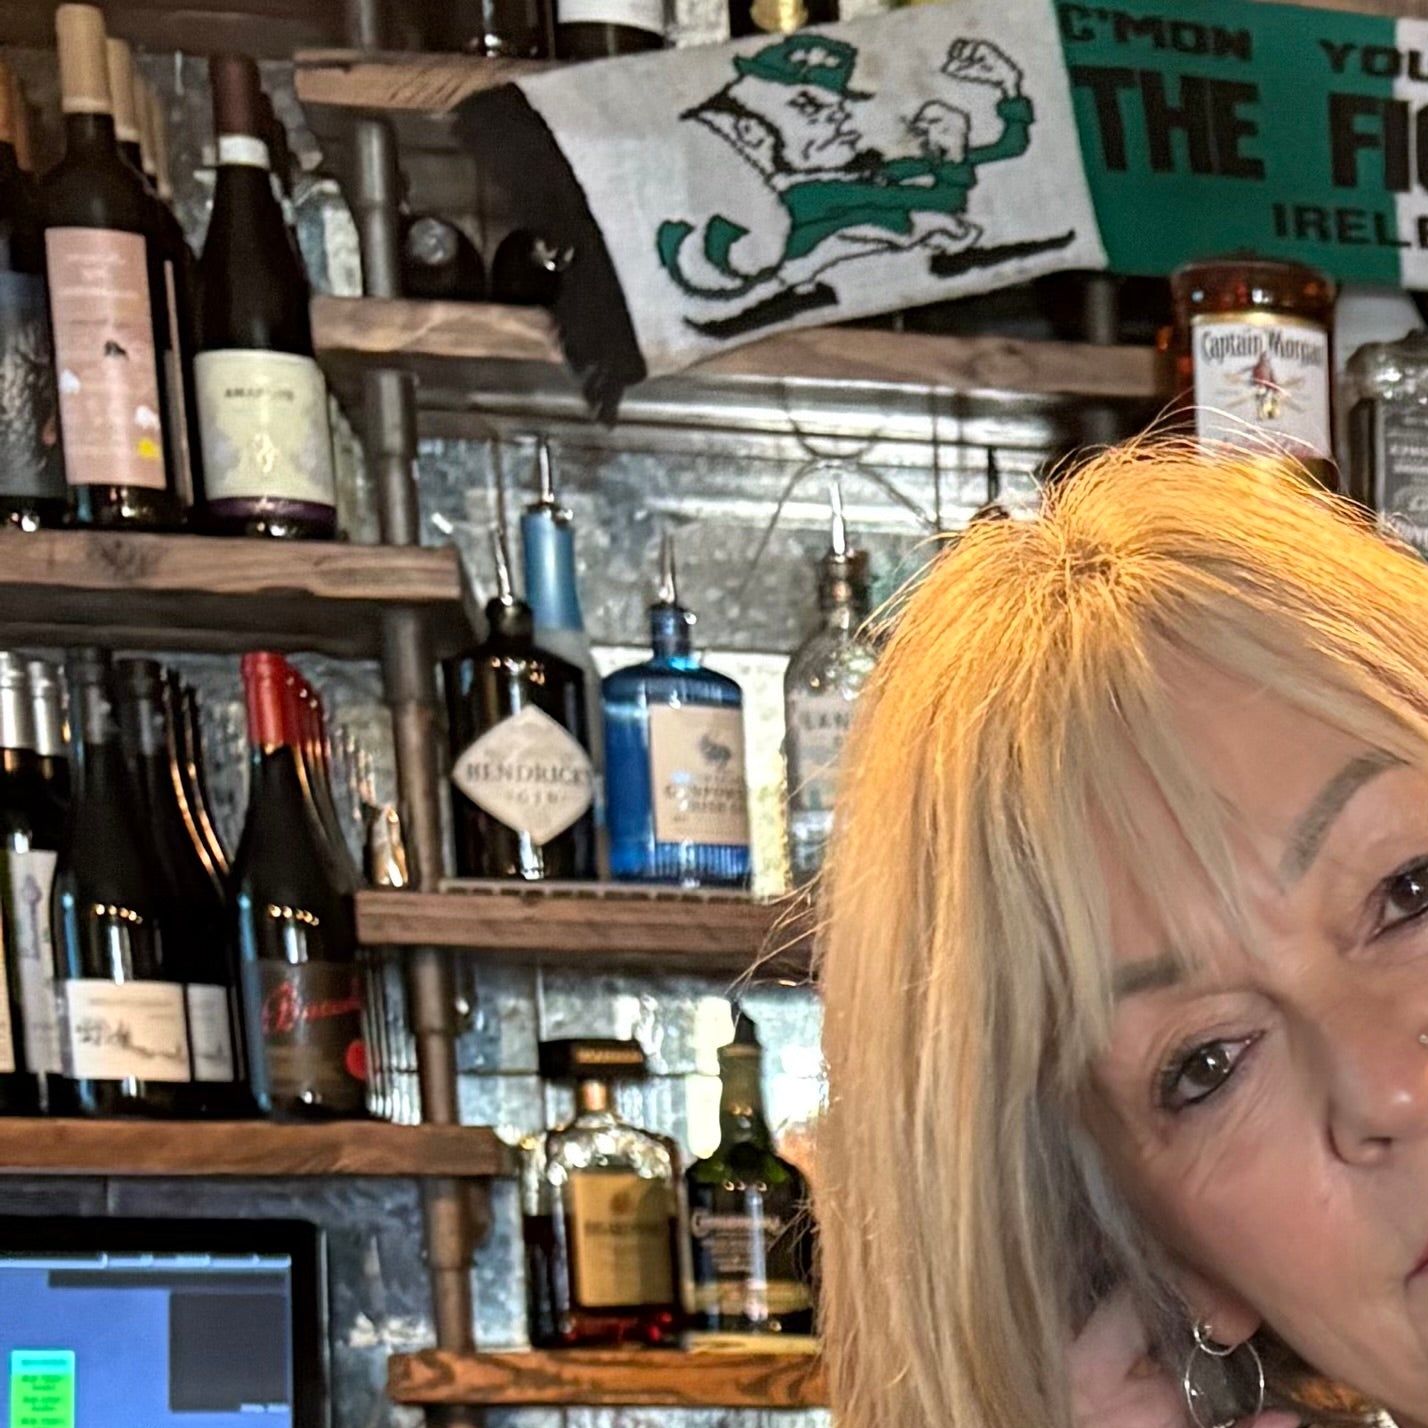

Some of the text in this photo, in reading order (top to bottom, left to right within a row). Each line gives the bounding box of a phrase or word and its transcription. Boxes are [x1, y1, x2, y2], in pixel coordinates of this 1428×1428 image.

[1061, 4, 1251, 62] C'MON
[1069, 65, 1265, 181] THE
[1202, 329, 1264, 365] Captain
